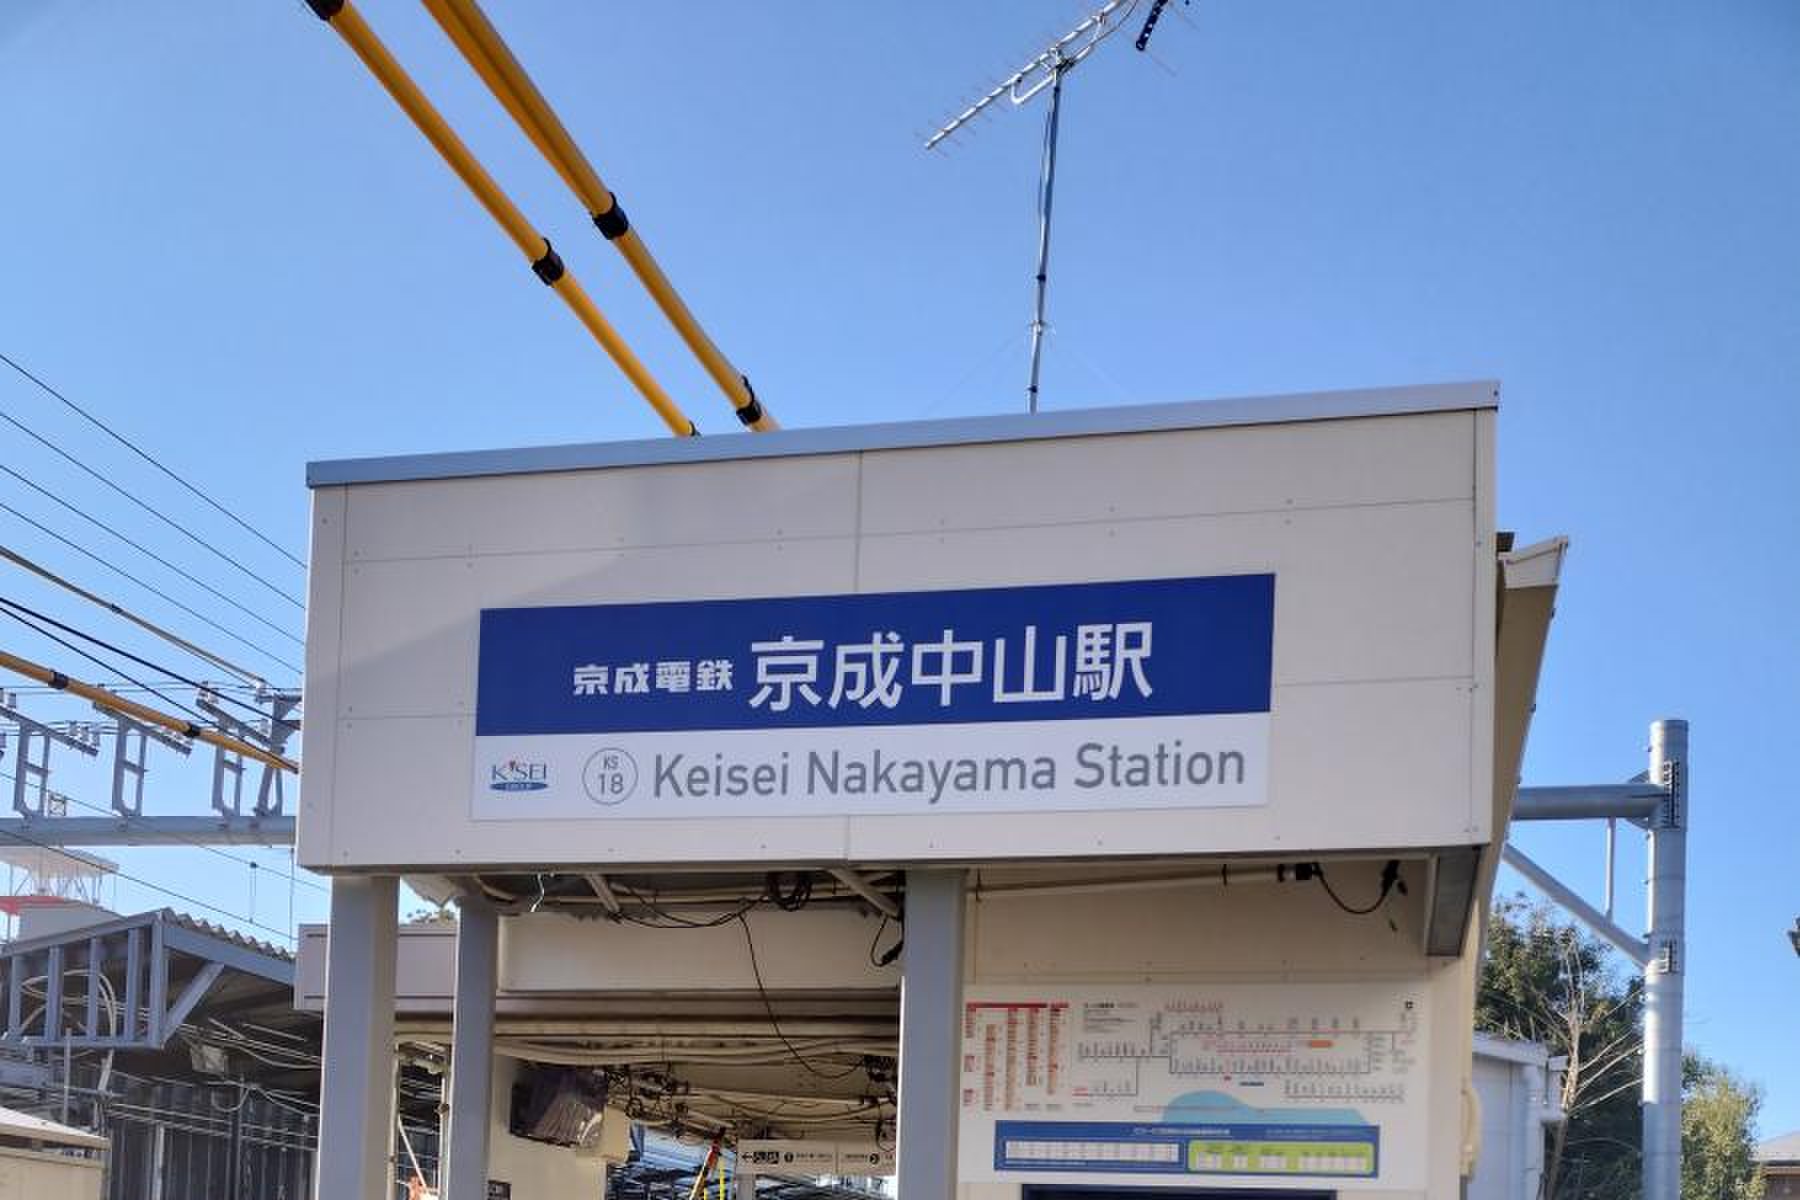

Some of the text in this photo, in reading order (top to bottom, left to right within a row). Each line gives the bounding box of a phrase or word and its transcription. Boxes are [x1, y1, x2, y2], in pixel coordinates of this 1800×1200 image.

[573, 622, 1153, 711] 京成電鉄 京成中山駅
[599, 773, 624, 795] 18
[603, 756, 619, 770] KS
[653, 740, 1244, 804] Keisei Nakayama Station
